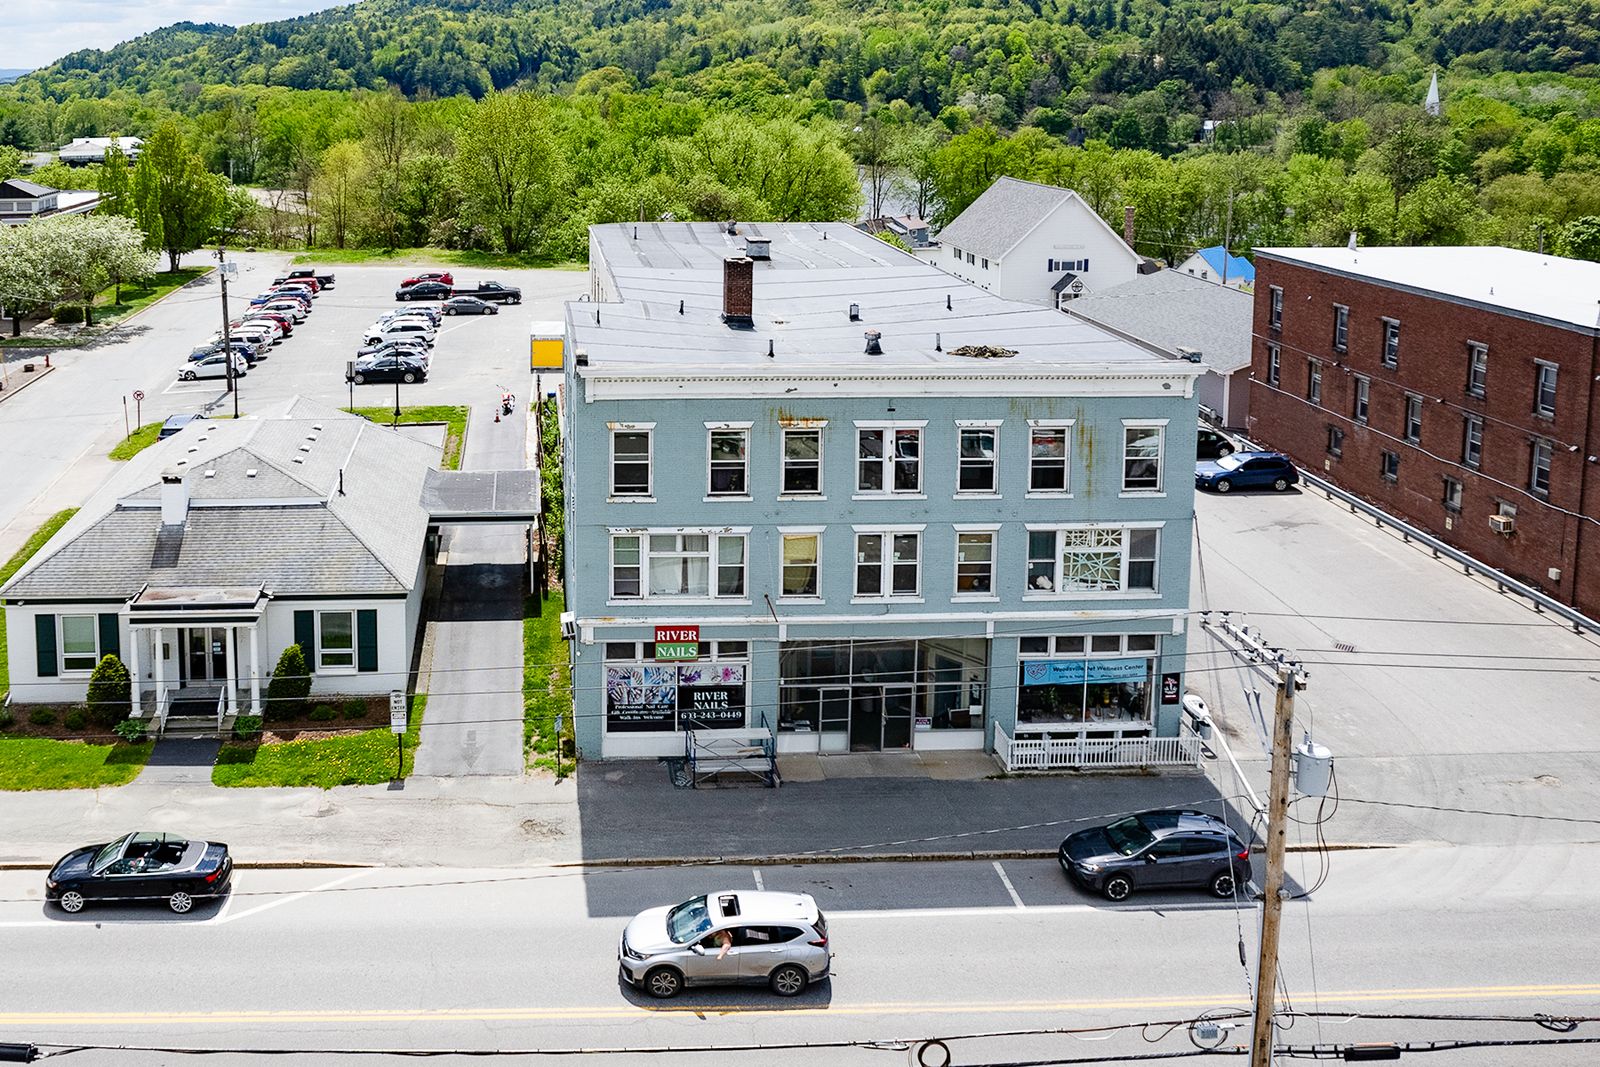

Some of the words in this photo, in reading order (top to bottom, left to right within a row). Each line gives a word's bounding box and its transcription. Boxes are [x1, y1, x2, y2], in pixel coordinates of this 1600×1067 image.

[656, 630, 697, 641] RIVER
[657, 646, 697, 657] NAILS
[693, 691, 728, 700] RIVER
[693, 701, 728, 710] NAILS
[680, 711, 742, 719] 603-243-0449
